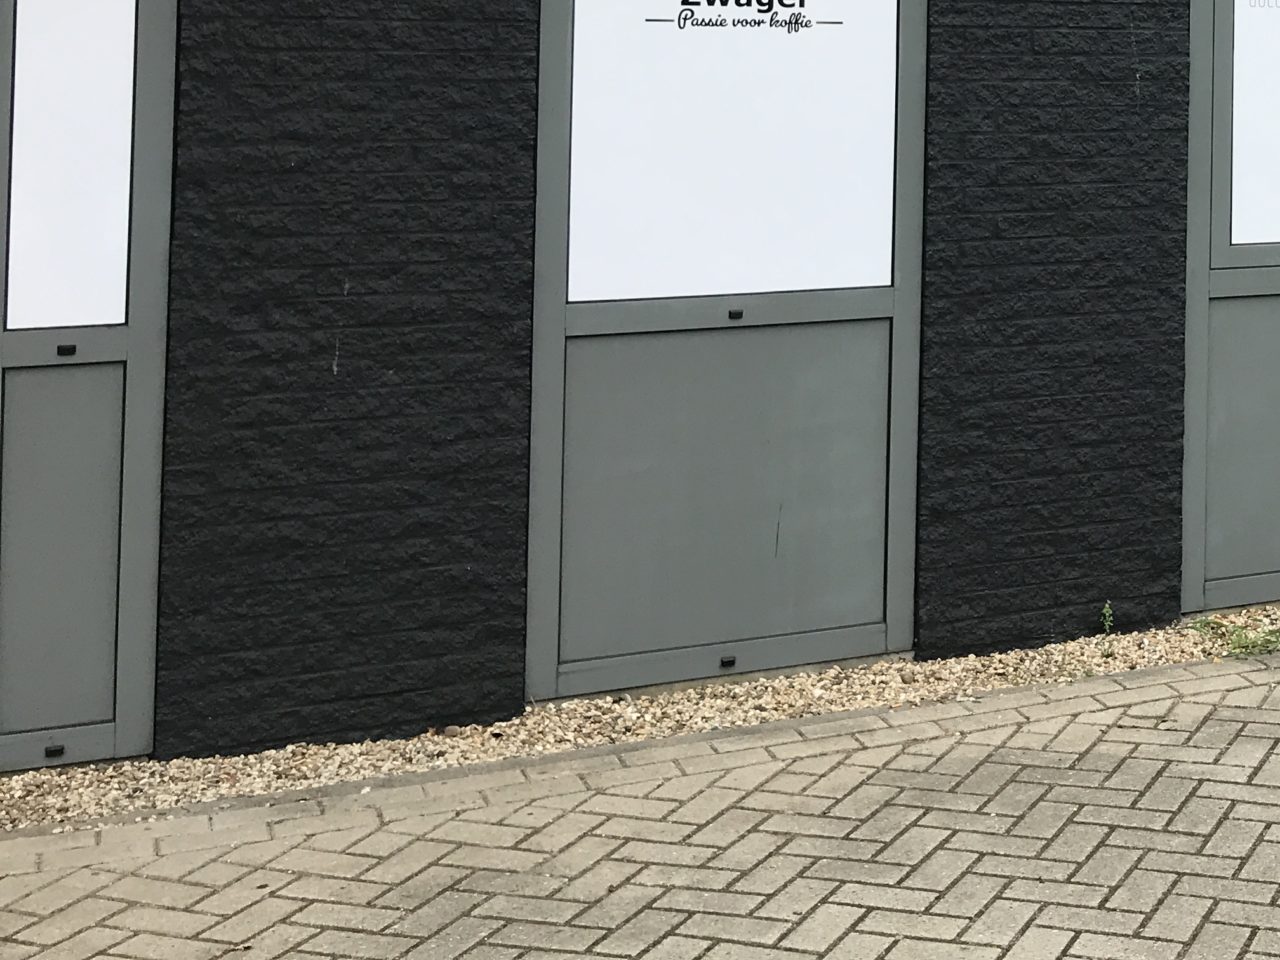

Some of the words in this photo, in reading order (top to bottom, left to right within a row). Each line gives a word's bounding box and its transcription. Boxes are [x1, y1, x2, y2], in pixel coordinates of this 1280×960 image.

[678, 9, 729, 30] Passie
[732, 17, 767, 28] voor
[770, 12, 814, 34] koffie
